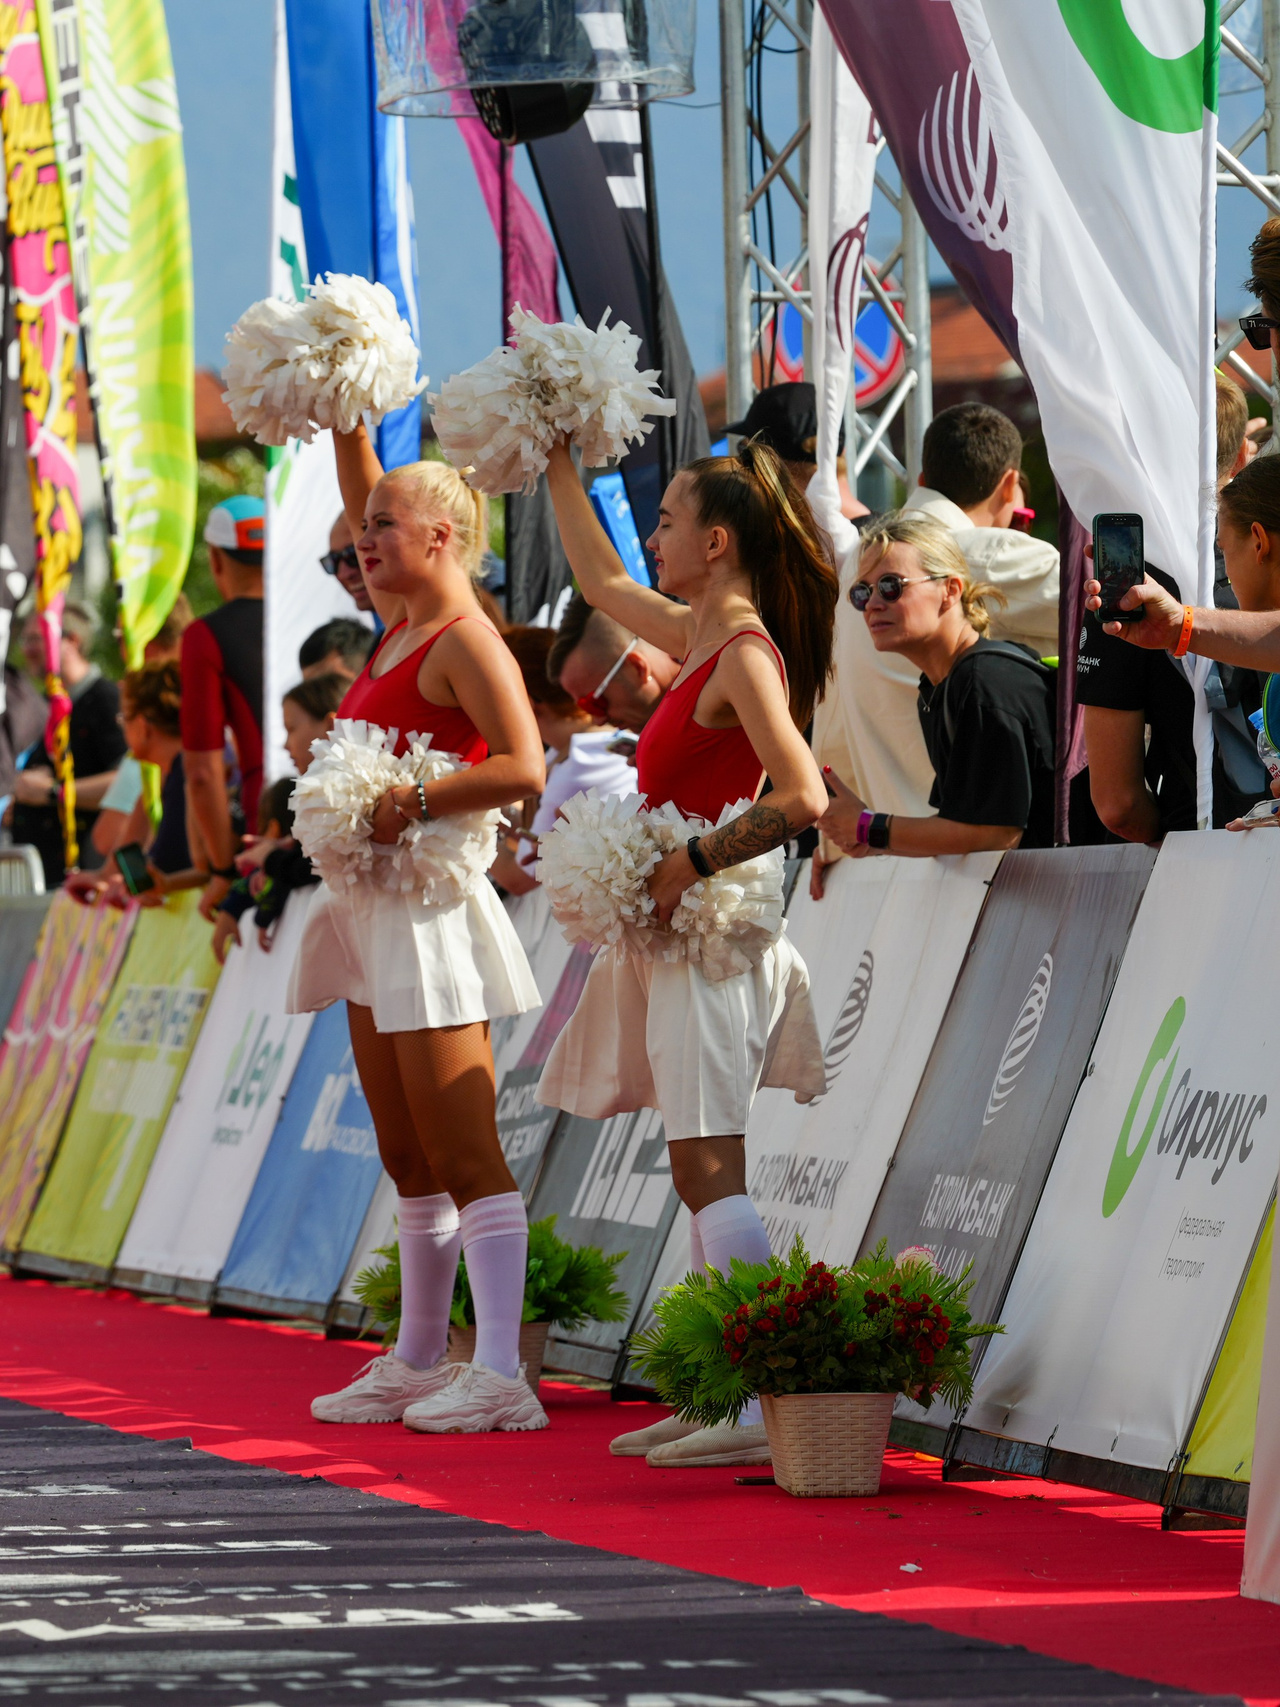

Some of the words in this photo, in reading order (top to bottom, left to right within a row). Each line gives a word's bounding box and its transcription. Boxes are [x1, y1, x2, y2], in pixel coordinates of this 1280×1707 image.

[1157, 1068, 1267, 1185] Сириус
[920, 1174, 1016, 1238] ГАЗПРОМБАНК
[1178, 1210, 1225, 1241] федеральная
[1164, 1258, 1205, 1283] территория
[133, 1601, 580, 1628] STAR
